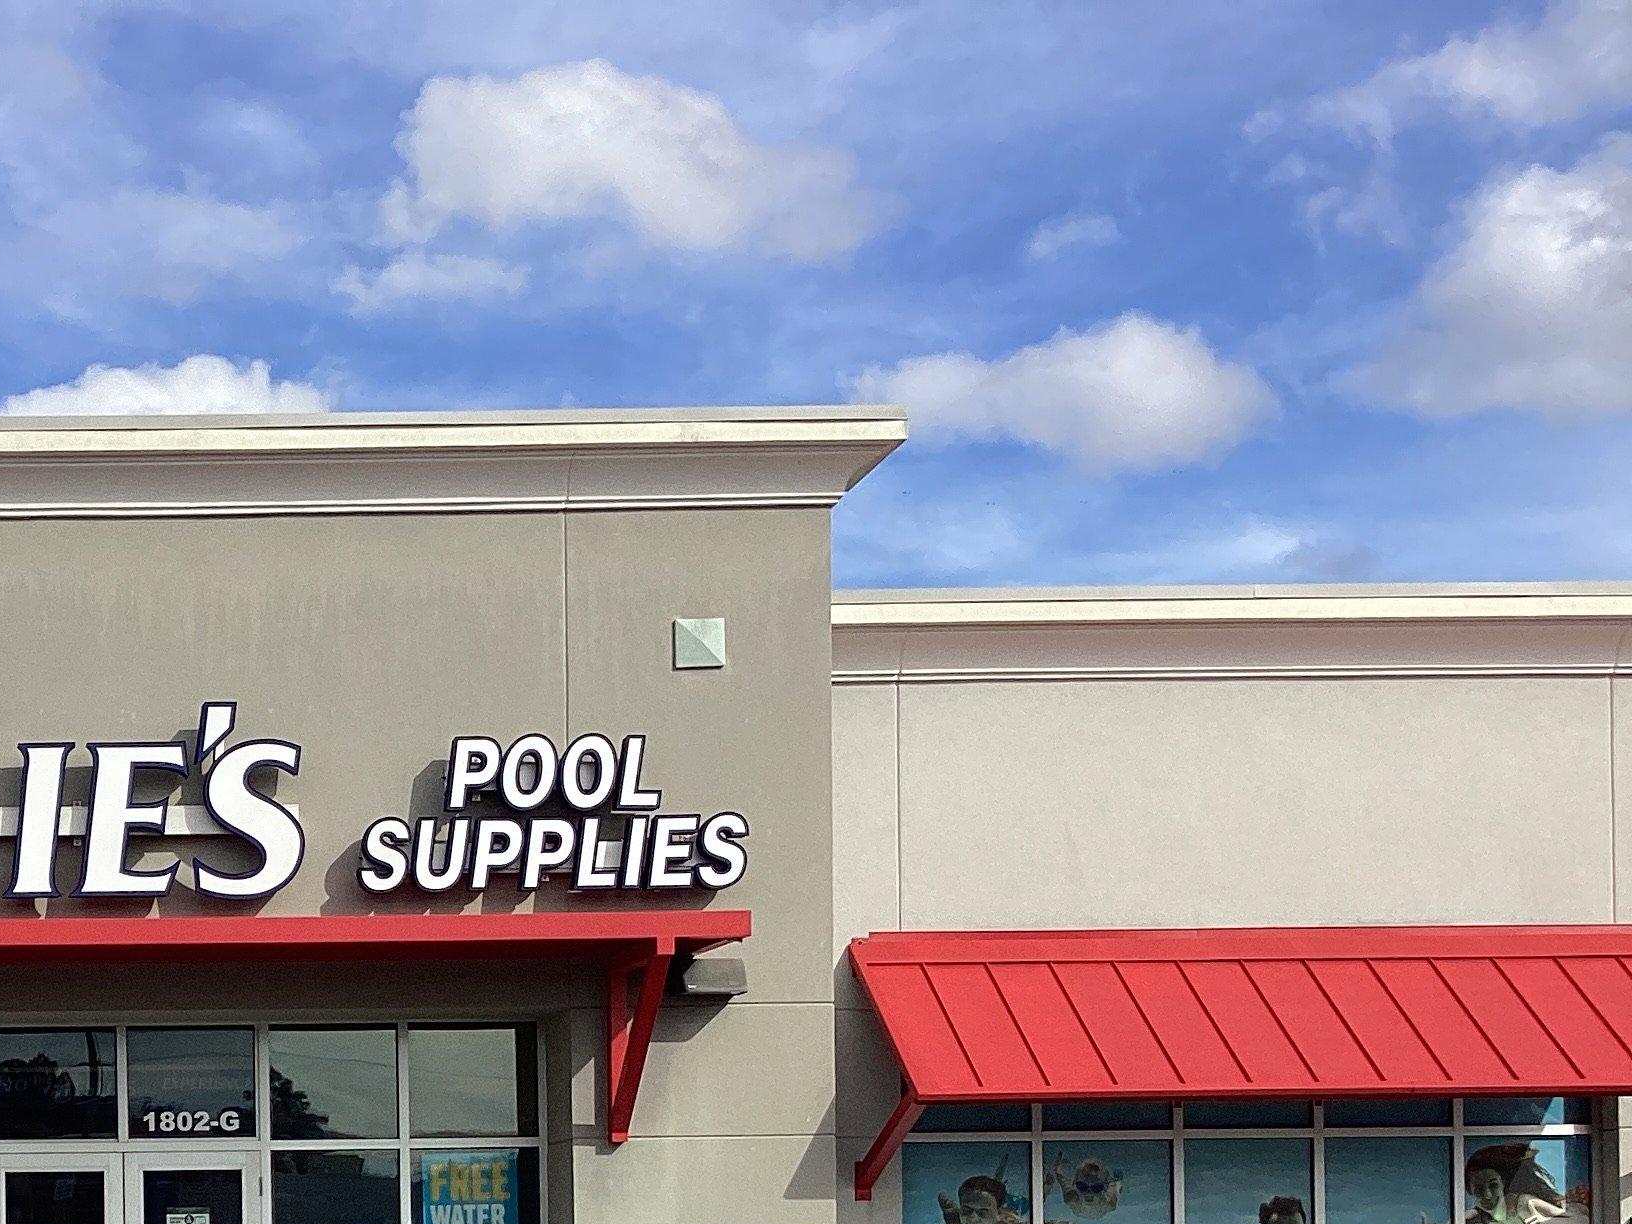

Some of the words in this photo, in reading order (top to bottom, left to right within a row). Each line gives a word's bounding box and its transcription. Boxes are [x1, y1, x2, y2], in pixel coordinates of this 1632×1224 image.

[445, 733, 662, 812] POOL
[357, 812, 749, 893] SUPPLIES
[143, 1110, 240, 1132] 1802-G
[430, 1161, 510, 1201] FREE
